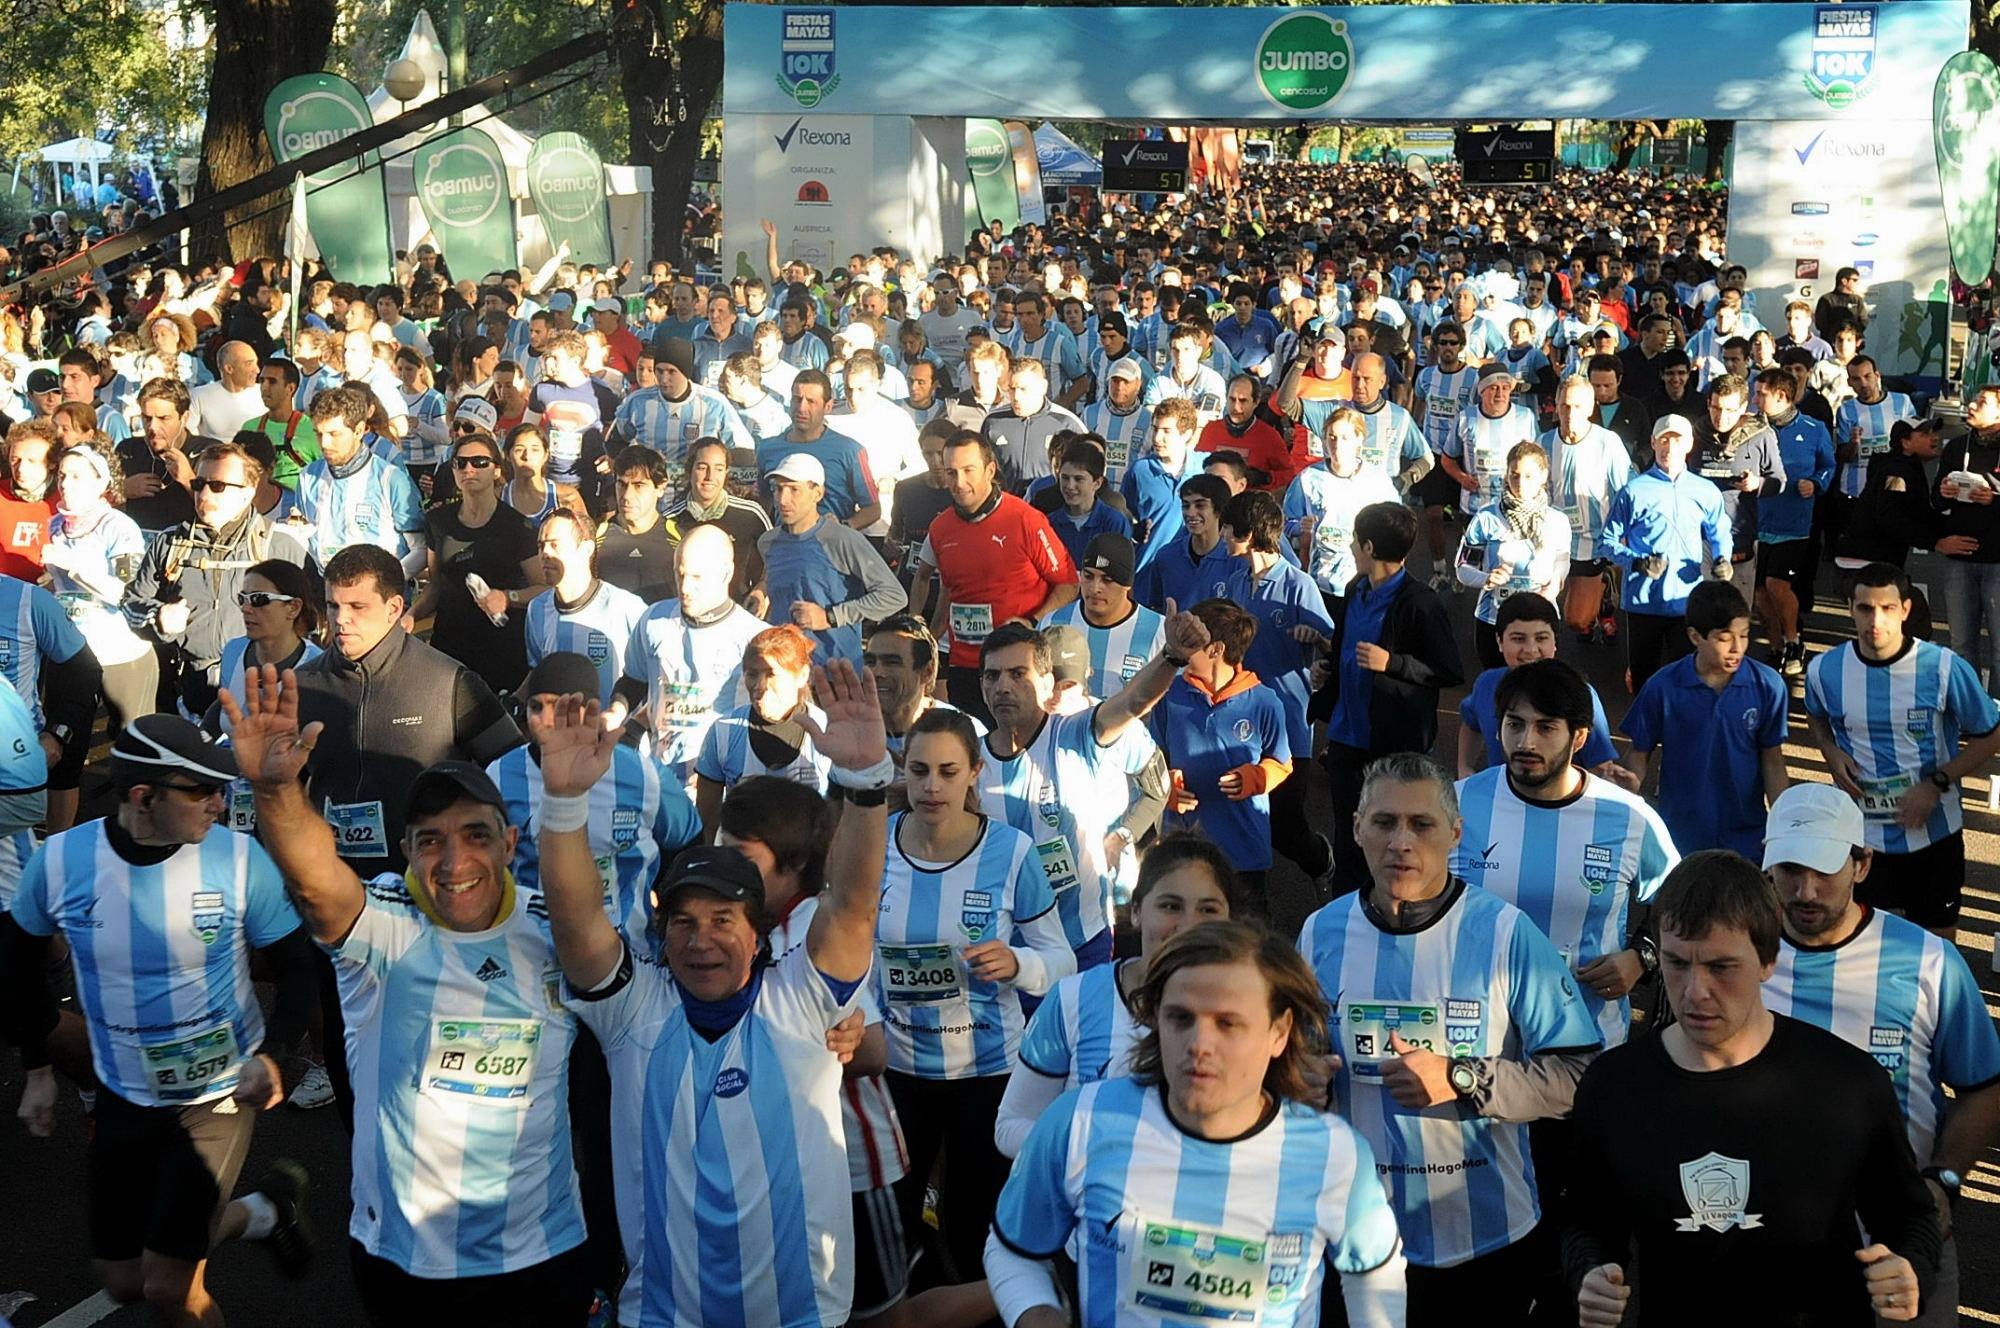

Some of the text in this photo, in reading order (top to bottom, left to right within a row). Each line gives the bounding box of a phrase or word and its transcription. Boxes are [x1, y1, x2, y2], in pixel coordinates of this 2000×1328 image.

[786, 15, 830, 26] FIESTAS
[1819, 10, 1872, 23] FIESTAS
[786, 27, 830, 38] MAYAS
[1818, 23, 1871, 36] MAYAS
[787, 54, 829, 74] 10K
[1262, 51, 1347, 71] JUMBO
[1816, 52, 1868, 76] 10K
[1279, 86, 1328, 96] cencosud
[800, 128, 851, 146] Rexona
[1500, 140, 1533, 151] Rexona
[1824, 139, 1885, 157] Rexona
[1137, 150, 1169, 162] Rexona
[13, 738, 26, 754] G
[345, 826, 374, 842] 622
[1468, 858, 1500, 870] Rexona
[1586, 866, 1608, 880] 10K
[964, 913, 988, 925] 10K
[907, 968, 956, 987] 3408
[1448, 1001, 1480, 1010] FIESTAS
[1448, 1009, 1480, 1018] MAYAS
[1448, 1026, 1478, 1041] 10K
[1383, 1038, 1434, 1056] 43
[186, 1054, 230, 1081] 6579
[474, 1056, 528, 1076] 6587
[1873, 1054, 1901, 1068] 0K
[716, 1079, 744, 1093] SOCIAL
[1184, 1272, 1254, 1299] 4584
